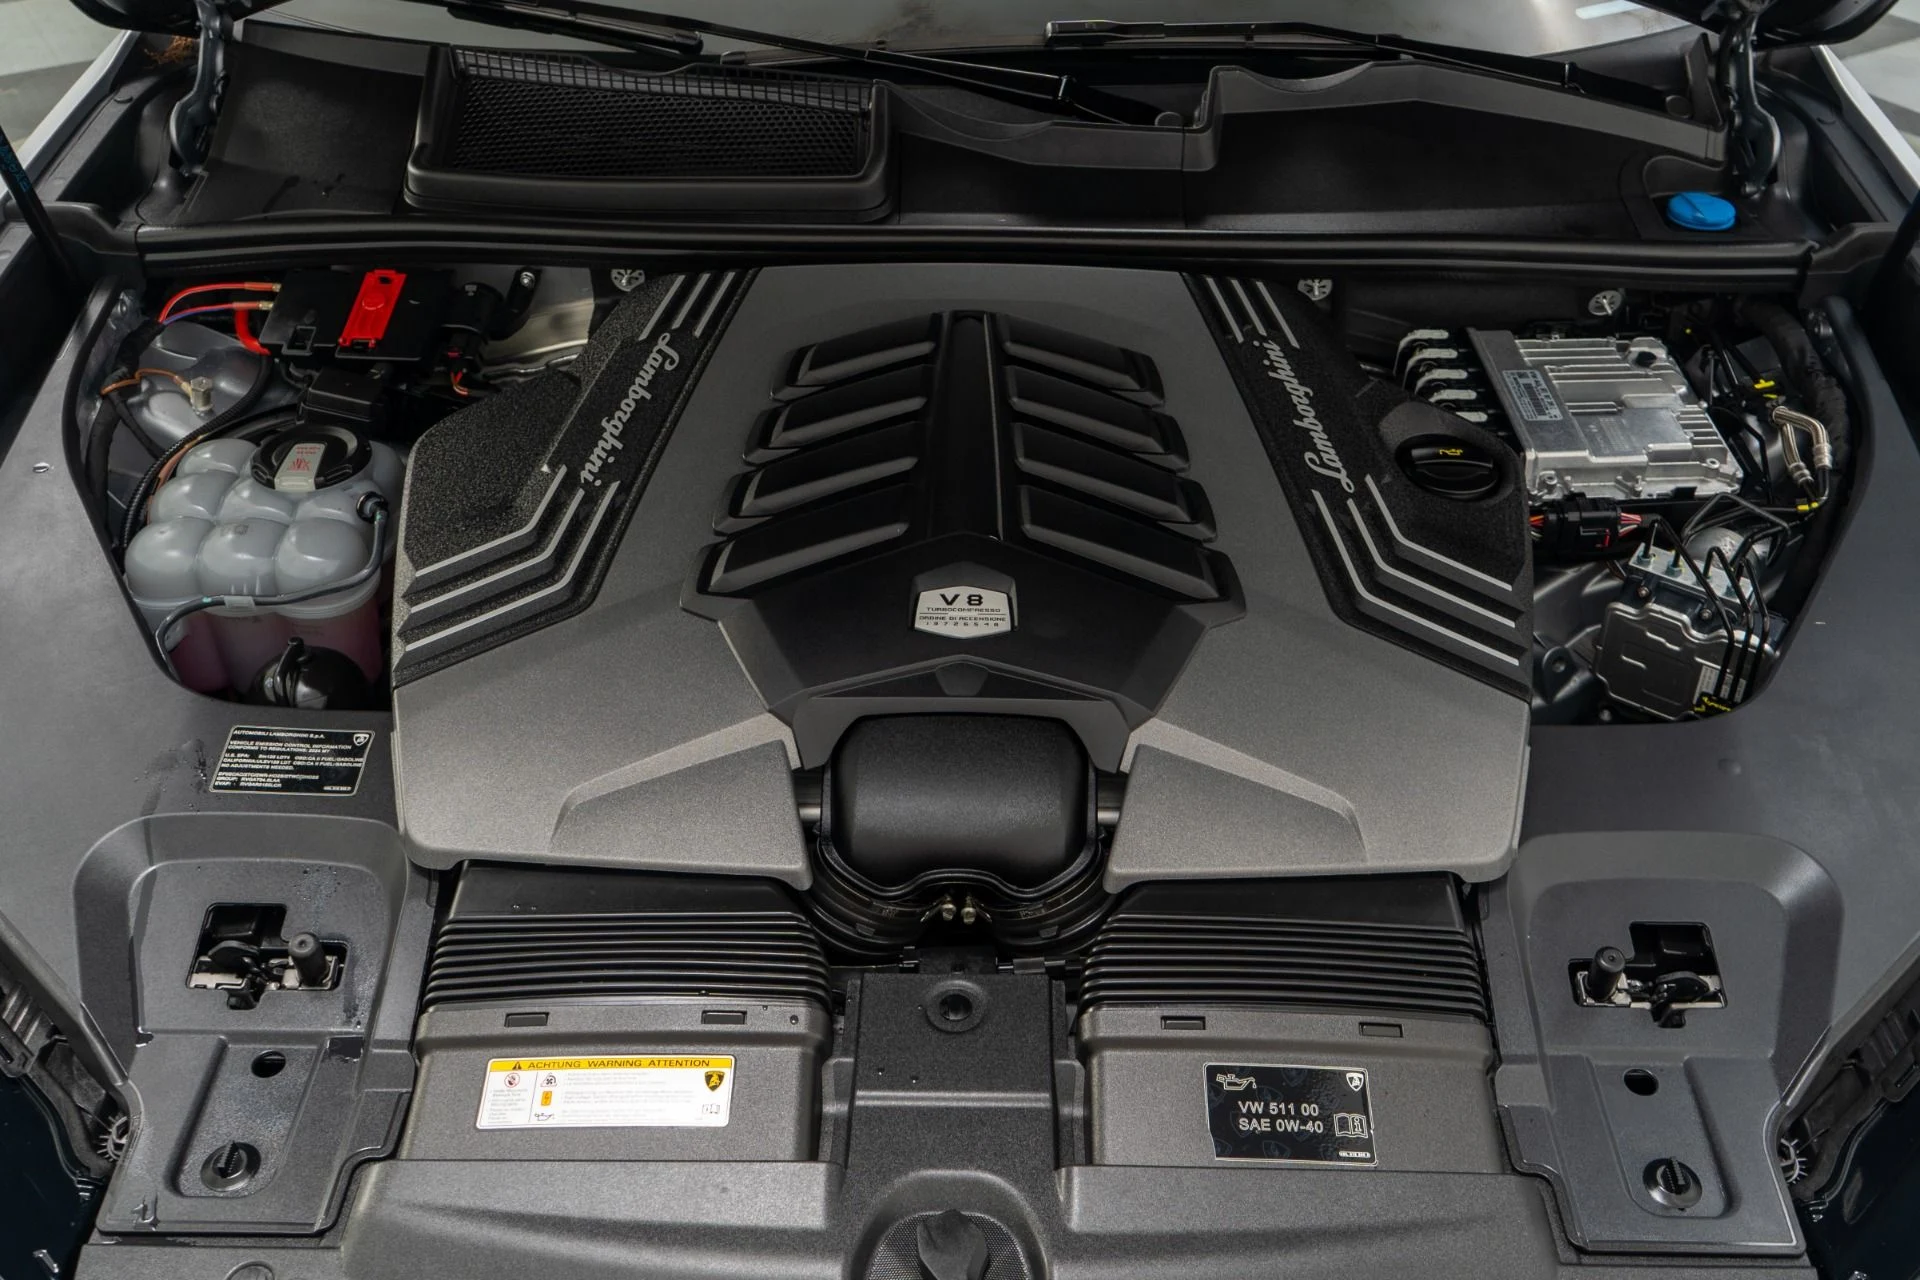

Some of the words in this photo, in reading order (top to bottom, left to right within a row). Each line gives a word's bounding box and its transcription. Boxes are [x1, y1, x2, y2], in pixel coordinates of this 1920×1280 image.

[581, 332, 680, 486] Lamborghini
[1253, 340, 1354, 493] Lamborghini
[528, 1061, 581, 1069] ACHTUNG
[648, 1058, 710, 1067] ATTENTION
[1238, 1101, 1264, 1113] VW
[1270, 1102, 1294, 1115] 511
[1301, 1104, 1319, 1116] 00
[1239, 1118, 1271, 1131] SAE
[1276, 1119, 1323, 1133] 0W-40
